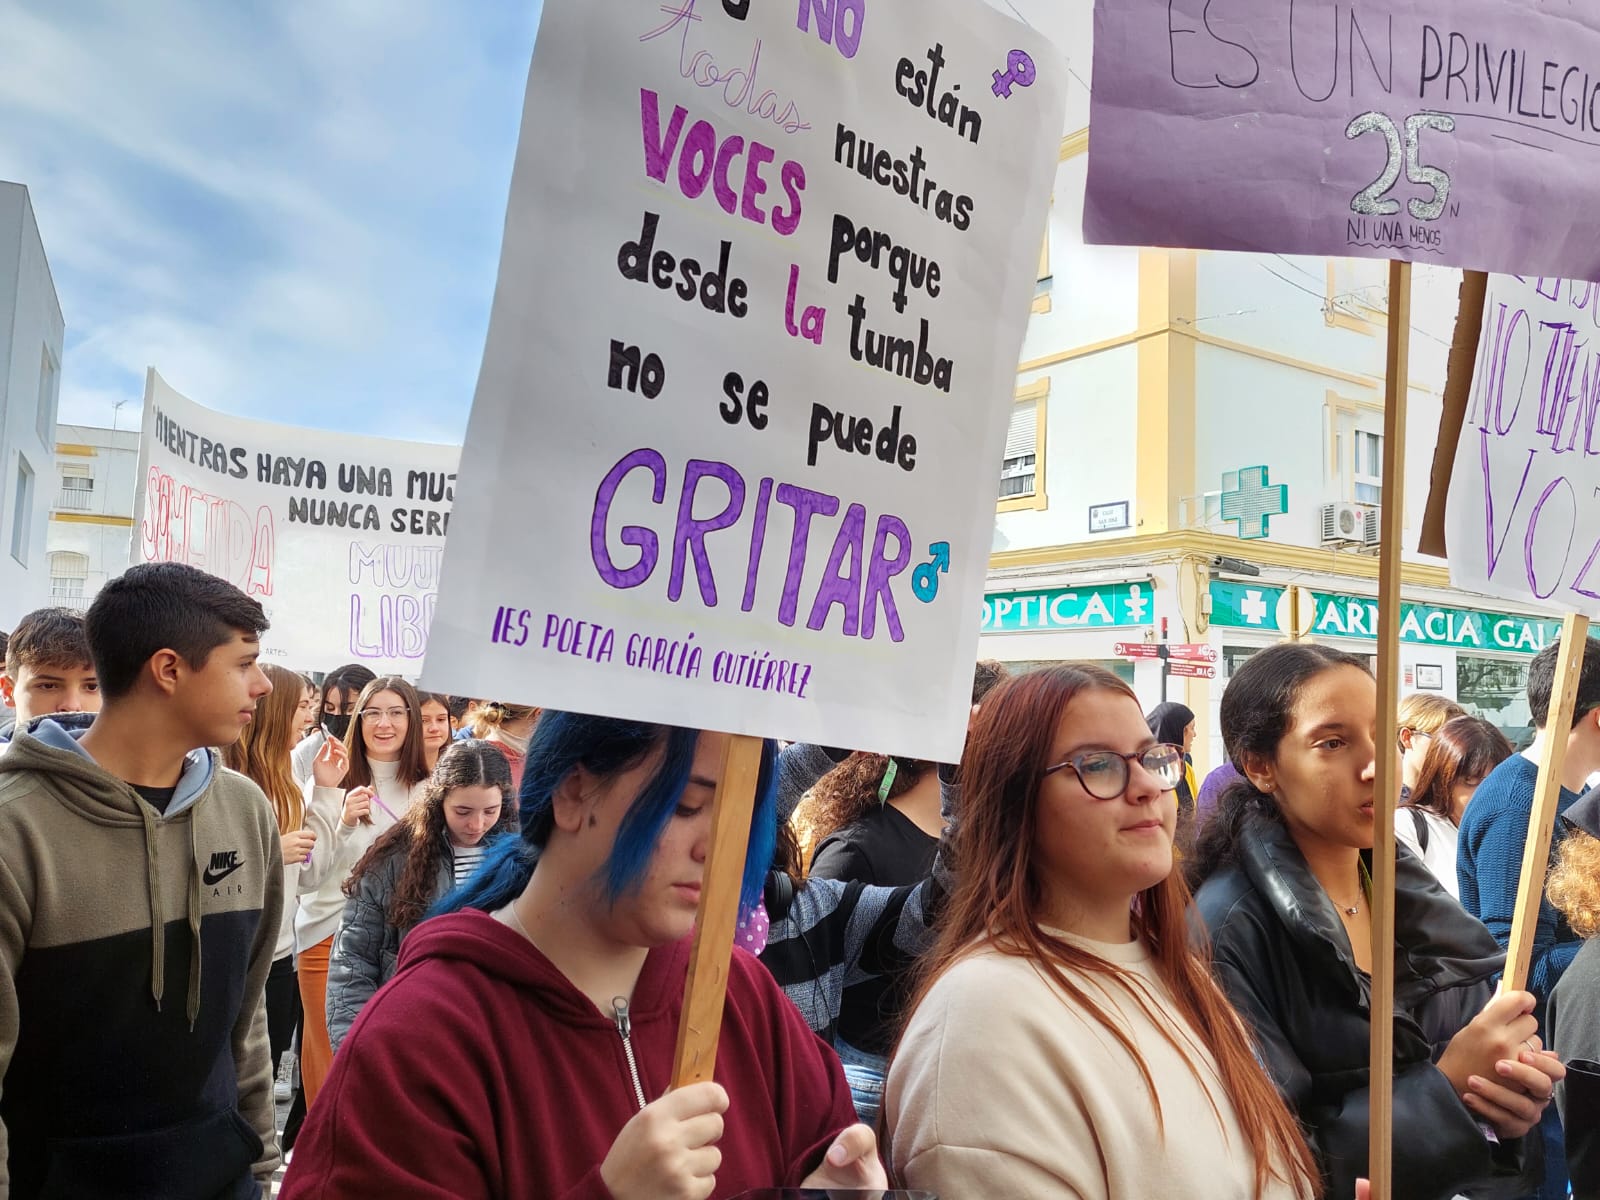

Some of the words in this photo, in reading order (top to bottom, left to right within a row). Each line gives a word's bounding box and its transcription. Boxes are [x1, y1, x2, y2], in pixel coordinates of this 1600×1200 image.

[797, 0, 865, 59] NO
[895, 43, 982, 144] están
[1290, 0, 1392, 102] UN
[640, 0, 811, 134] todas
[835, 123, 974, 231] nuestras
[640, 88, 806, 235] VOCES
[827, 214, 940, 314] porque
[1347, 219, 1366, 240] NI
[1373, 221, 1403, 242] UNA
[1409, 225, 1441, 246] MENOS
[618, 211, 747, 317] desde
[785, 264, 826, 344] la
[848, 294, 953, 392] tumba
[607, 339, 665, 399] no
[719, 372, 769, 430] se
[807, 403, 917, 471] puede
[257, 453, 326, 489] HAYA
[338, 462, 393, 497] UNA
[289, 496, 380, 531] NUNCA
[349, 541, 443, 589] MUJ
[590, 448, 912, 643] GRITAR
[491, 606, 531, 647] IES
[543, 614, 614, 663] POETA
[626, 632, 702, 679] GARCÍA
[713, 650, 812, 699] GUTIÉRREZ
[210, 851, 237, 870] NIKE
[213, 885, 242, 897] AIR
